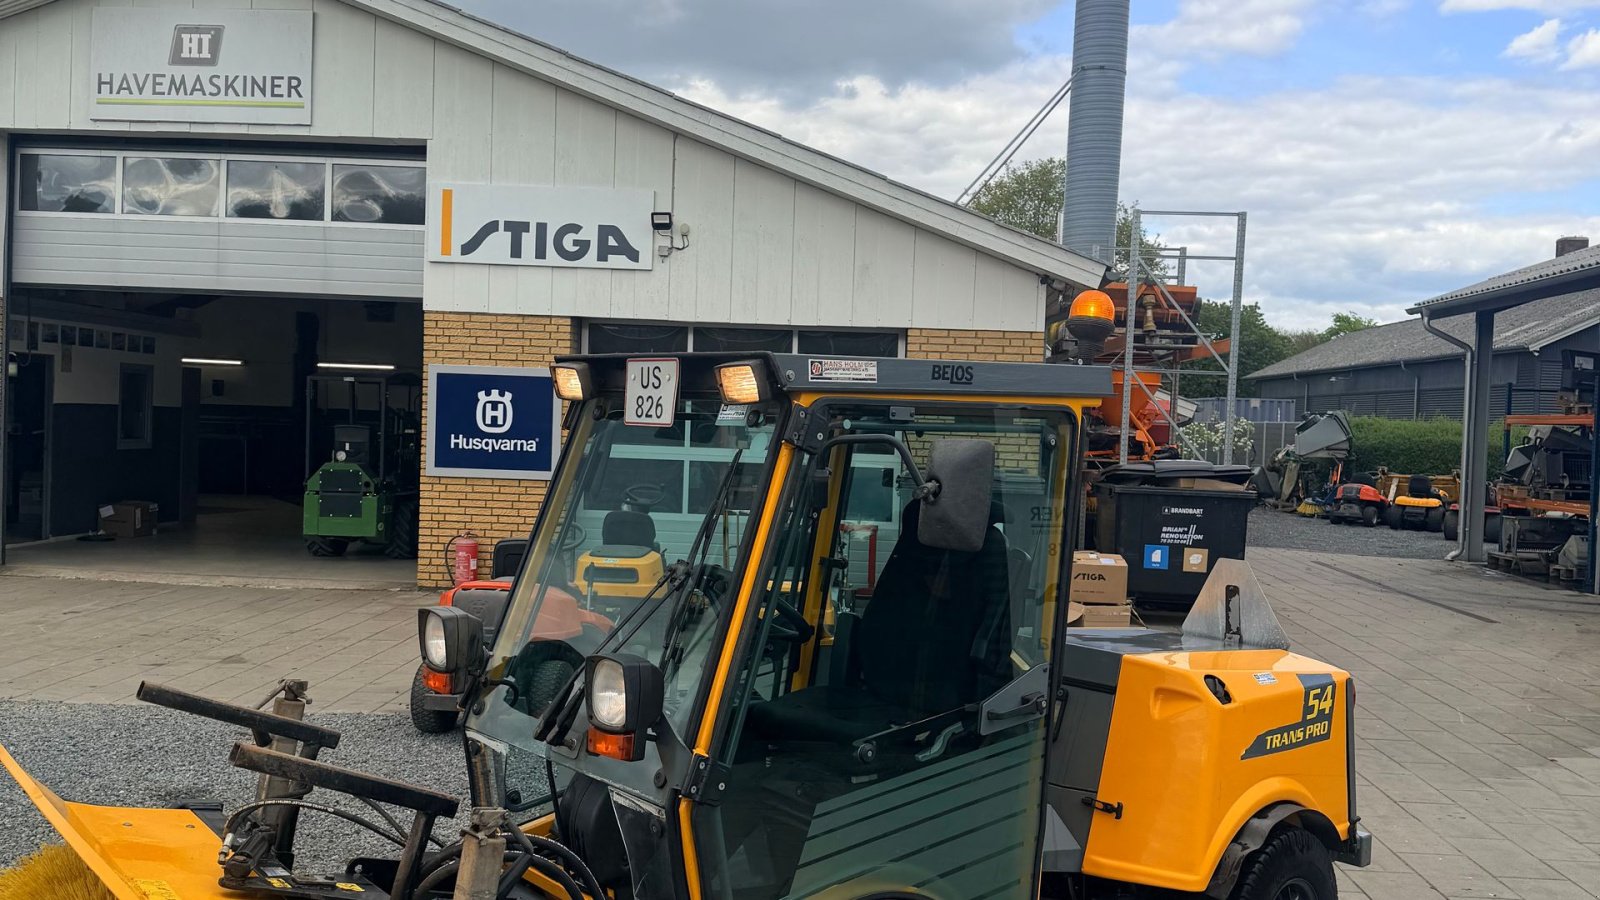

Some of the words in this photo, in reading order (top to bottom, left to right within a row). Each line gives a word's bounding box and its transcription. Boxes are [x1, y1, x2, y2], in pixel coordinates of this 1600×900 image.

[180, 33, 212, 59] HI
[96, 72, 304, 98] HAVEMASKINER
[460, 219, 640, 263] STIGA
[823, 360, 843, 368] HANS
[931, 364, 974, 385] BELOS
[640, 365, 662, 390] US
[635, 395, 664, 419] 826
[450, 433, 537, 453] Husqvarna
[1073, 572, 1106, 581] STIGA
[1306, 684, 1333, 720] 54
[1265, 727, 1304, 750] TRANS
[1305, 720, 1329, 740] PRO
